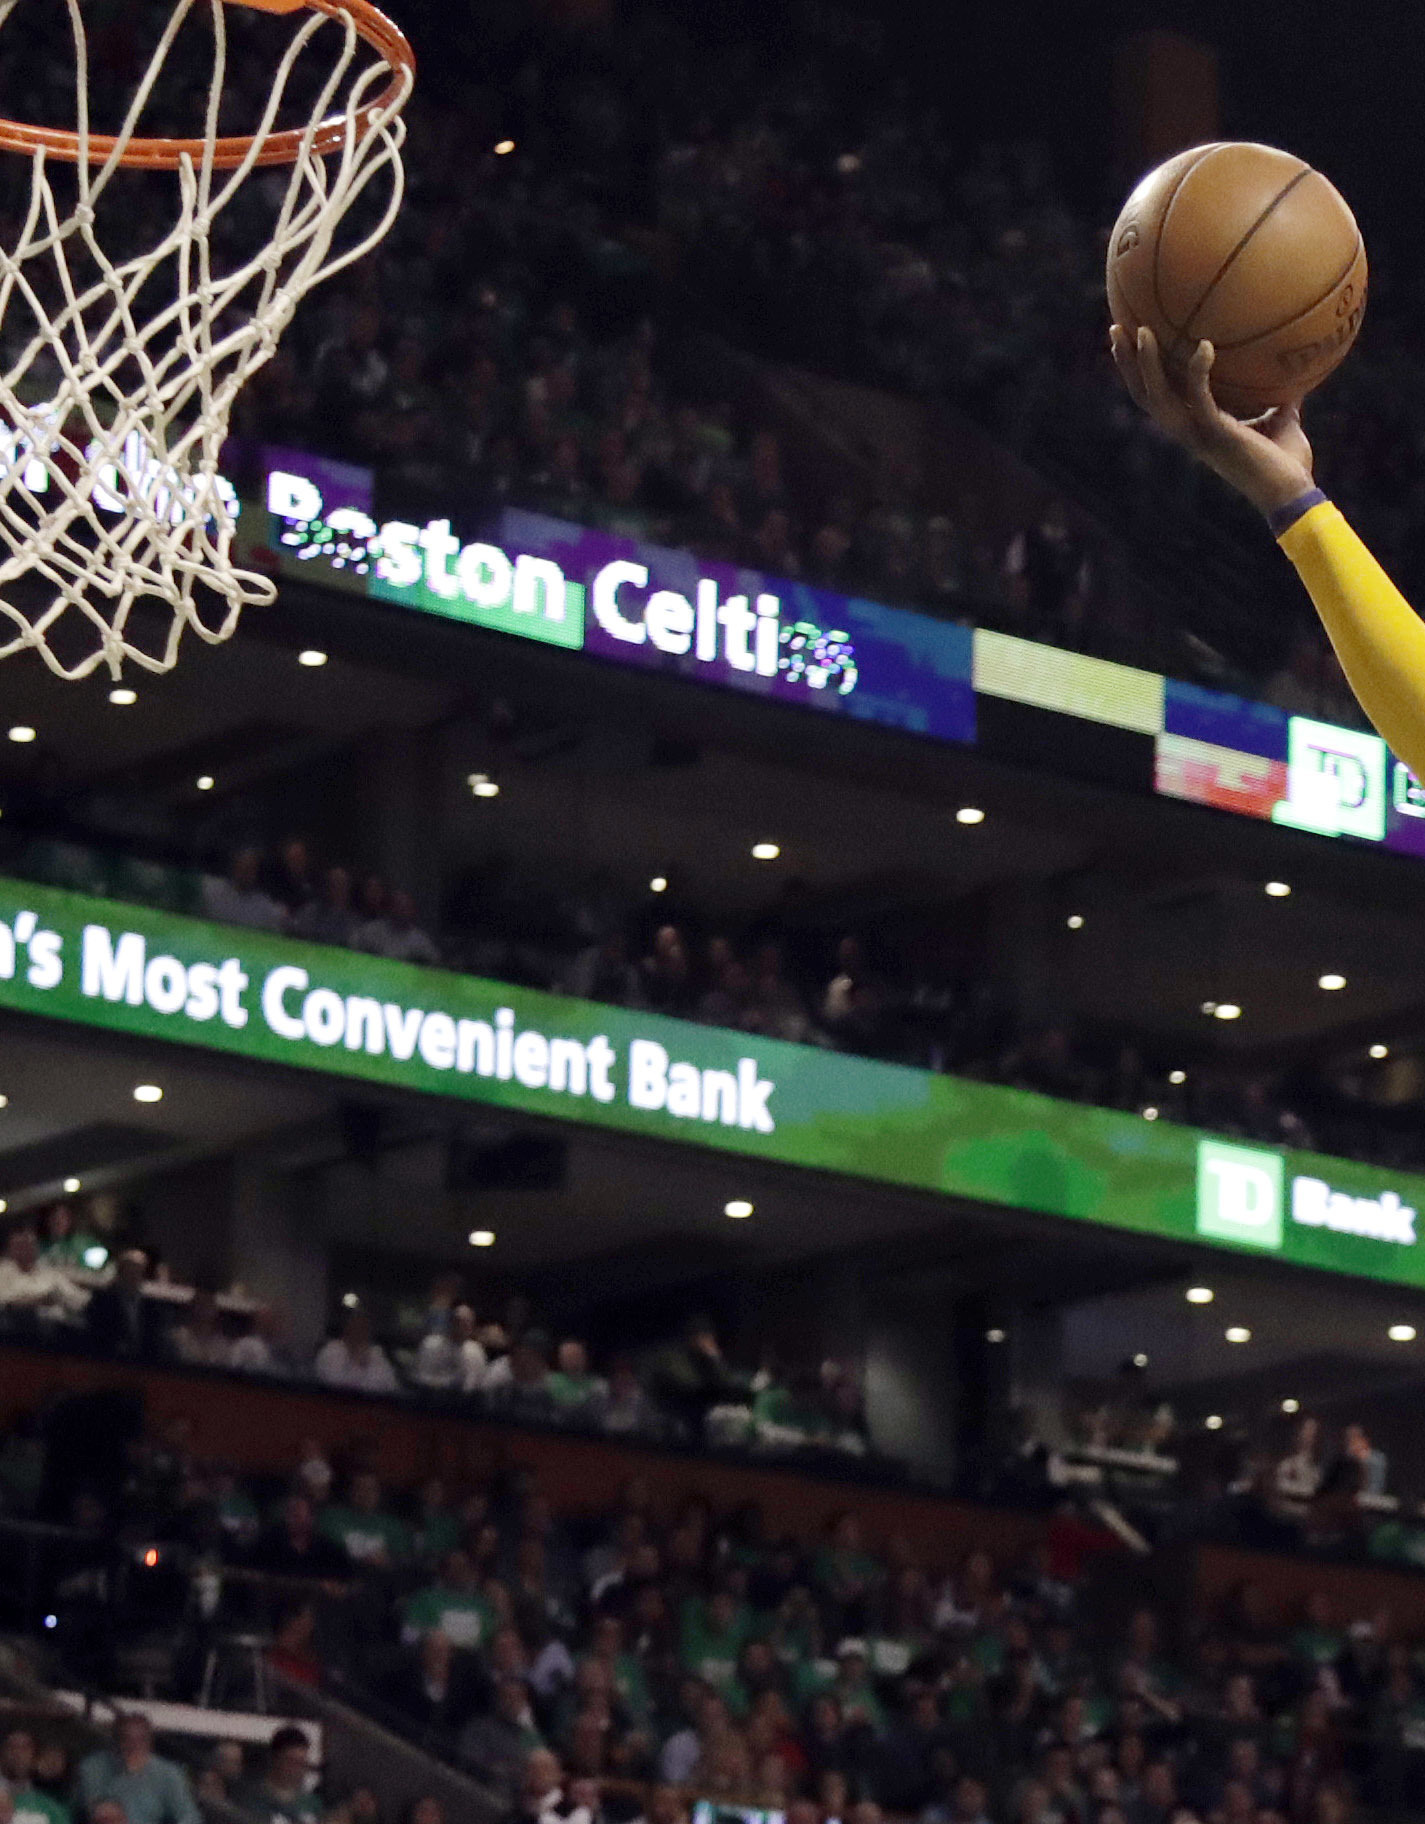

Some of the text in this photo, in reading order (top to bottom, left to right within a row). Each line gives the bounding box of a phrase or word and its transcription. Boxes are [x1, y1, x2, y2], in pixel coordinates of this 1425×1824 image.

[82, 924, 249, 1029] Most
[262, 965, 616, 1102] Convenient
[628, 1039, 776, 1133] Bank
[1204, 1158, 1417, 1245] TD Bank
